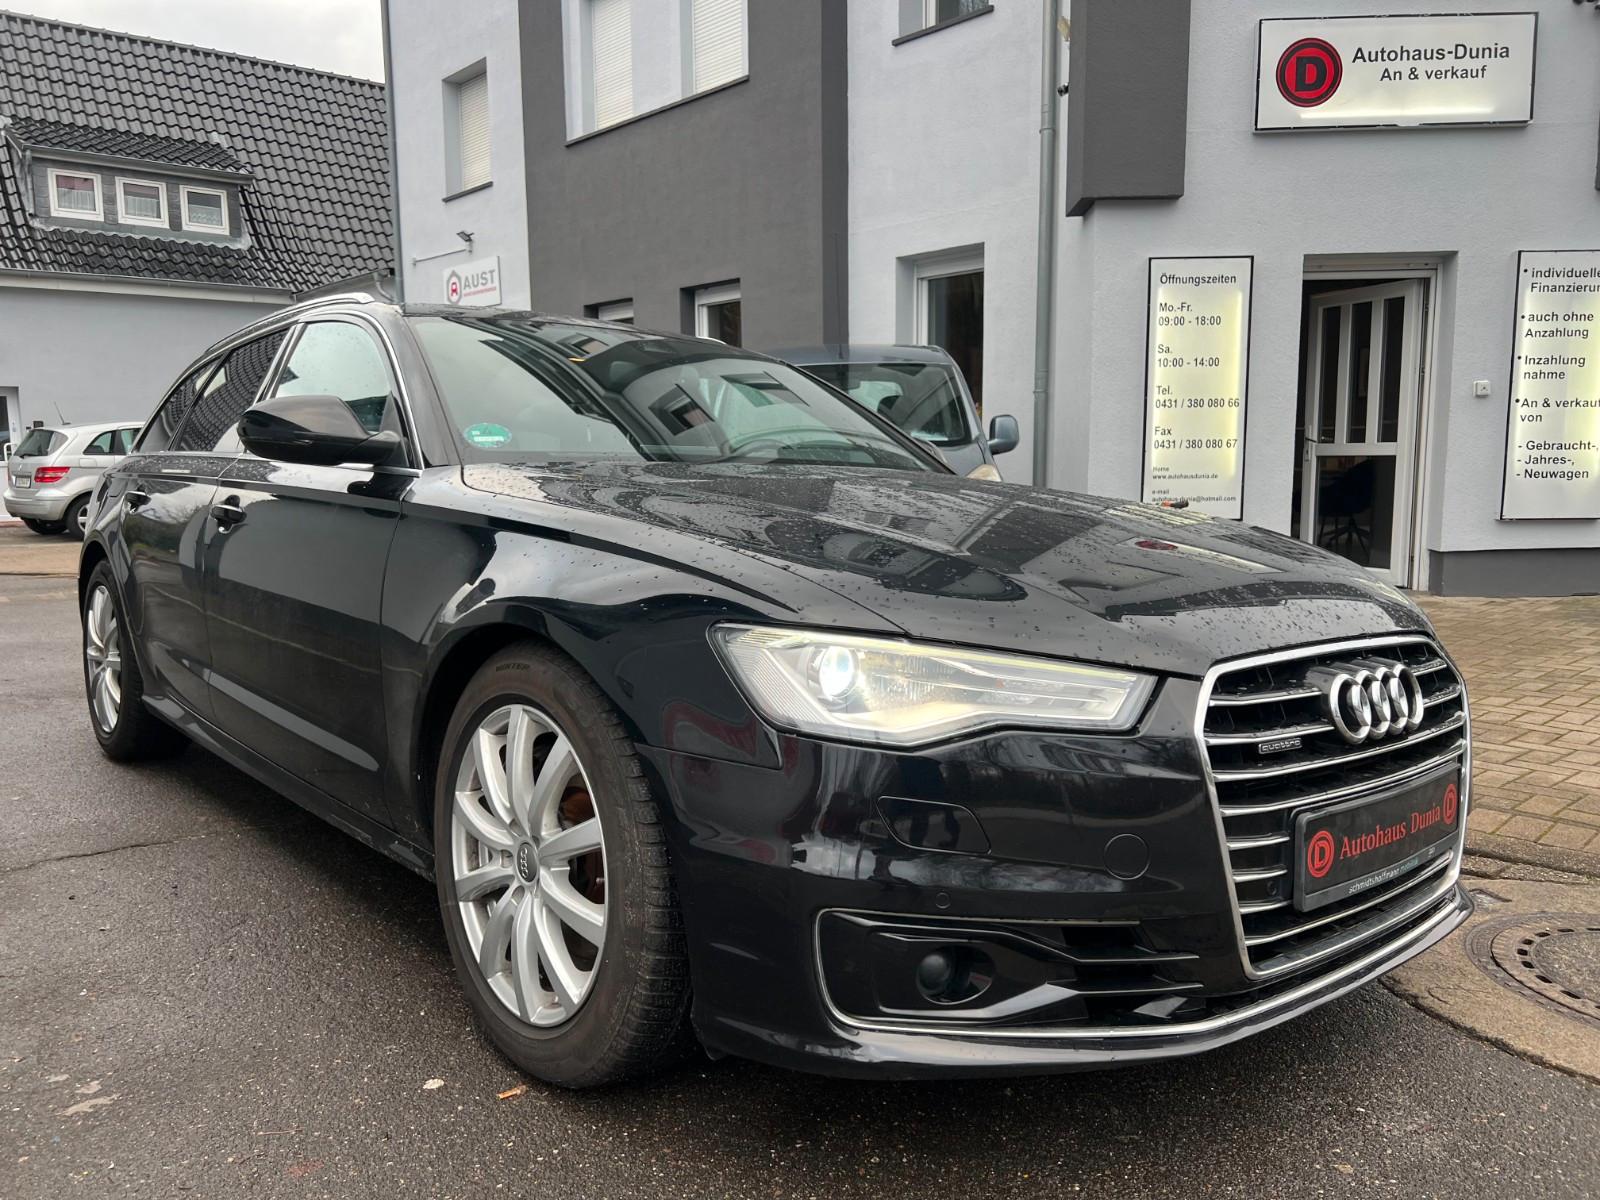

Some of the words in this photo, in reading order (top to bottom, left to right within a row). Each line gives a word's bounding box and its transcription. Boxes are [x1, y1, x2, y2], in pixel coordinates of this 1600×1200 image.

[1352, 43, 1510, 63] Autohaus-Dunia
[1295, 56, 1327, 92] D
[1380, 67, 1402, 81] An
[1408, 67, 1420, 80] &
[1425, 65, 1487, 80] verkauf
[464, 269, 496, 290] AUST
[1160, 273, 1237, 286] Öffnungszeiten
[1159, 302, 1193, 312] Mo.-Fr.
[1158, 316, 1185, 326] 09:00
[1195, 316, 1221, 326] 18:00
[1528, 312, 1559, 322] auch
[1563, 312, 1594, 322] ohne
[1525, 328, 1589, 339] Anzahlung
[1157, 344, 1173, 354] Sa.
[1157, 358, 1184, 367] 10:00
[1194, 357, 1220, 367] 14:00
[1525, 355, 1586, 367] Inzahlung
[1524, 370, 1566, 380] nahme
[1156, 385, 1173, 395] Tel.
[1155, 399, 1177, 408] 0431
[1187, 398, 1204, 408] 380
[1207, 398, 1225, 408] 080
[1228, 398, 1240, 408] 66
[1521, 398, 1538, 408] An
[1542, 398, 1551, 408] &
[1520, 414, 1543, 423] von
[1154, 426, 1172, 436] Fax
[1154, 440, 1176, 449] 0431
[1185, 439, 1203, 449] 380
[1205, 439, 1223, 449] 080
[1226, 439, 1238, 448] 67
[1525, 455, 1575, 465] Jahres-,
[1524, 469, 1589, 480] Neuwagen
[1262, 739, 1301, 751] quattro
[1340, 822, 1406, 859] Autohaus
[1411, 803, 1441, 833] Dunia
